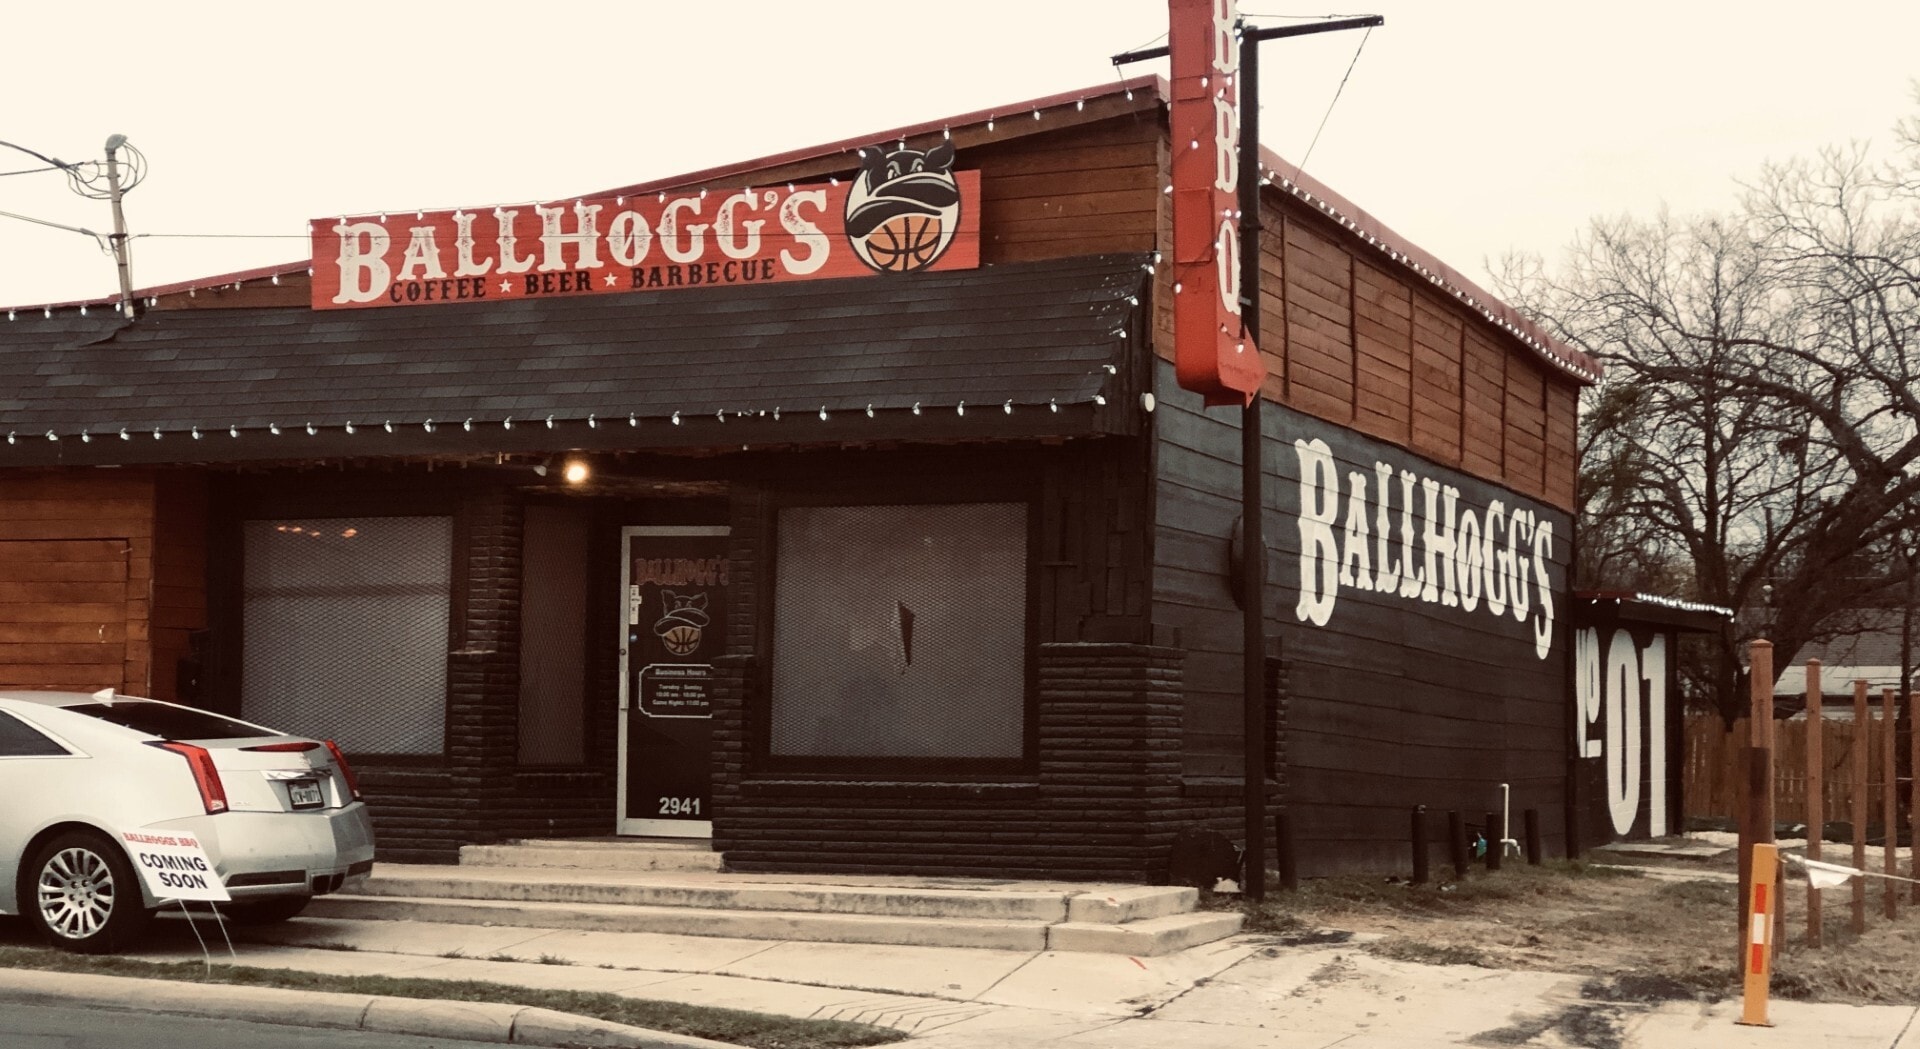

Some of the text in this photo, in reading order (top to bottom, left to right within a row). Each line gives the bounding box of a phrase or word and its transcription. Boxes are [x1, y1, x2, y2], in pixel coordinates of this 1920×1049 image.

[389, 257, 777, 304] COFFEE BEER BARBECUE
[658, 796, 701, 816] 2941
[139, 852, 208, 872] COMING
[158, 872, 209, 890] SOON
